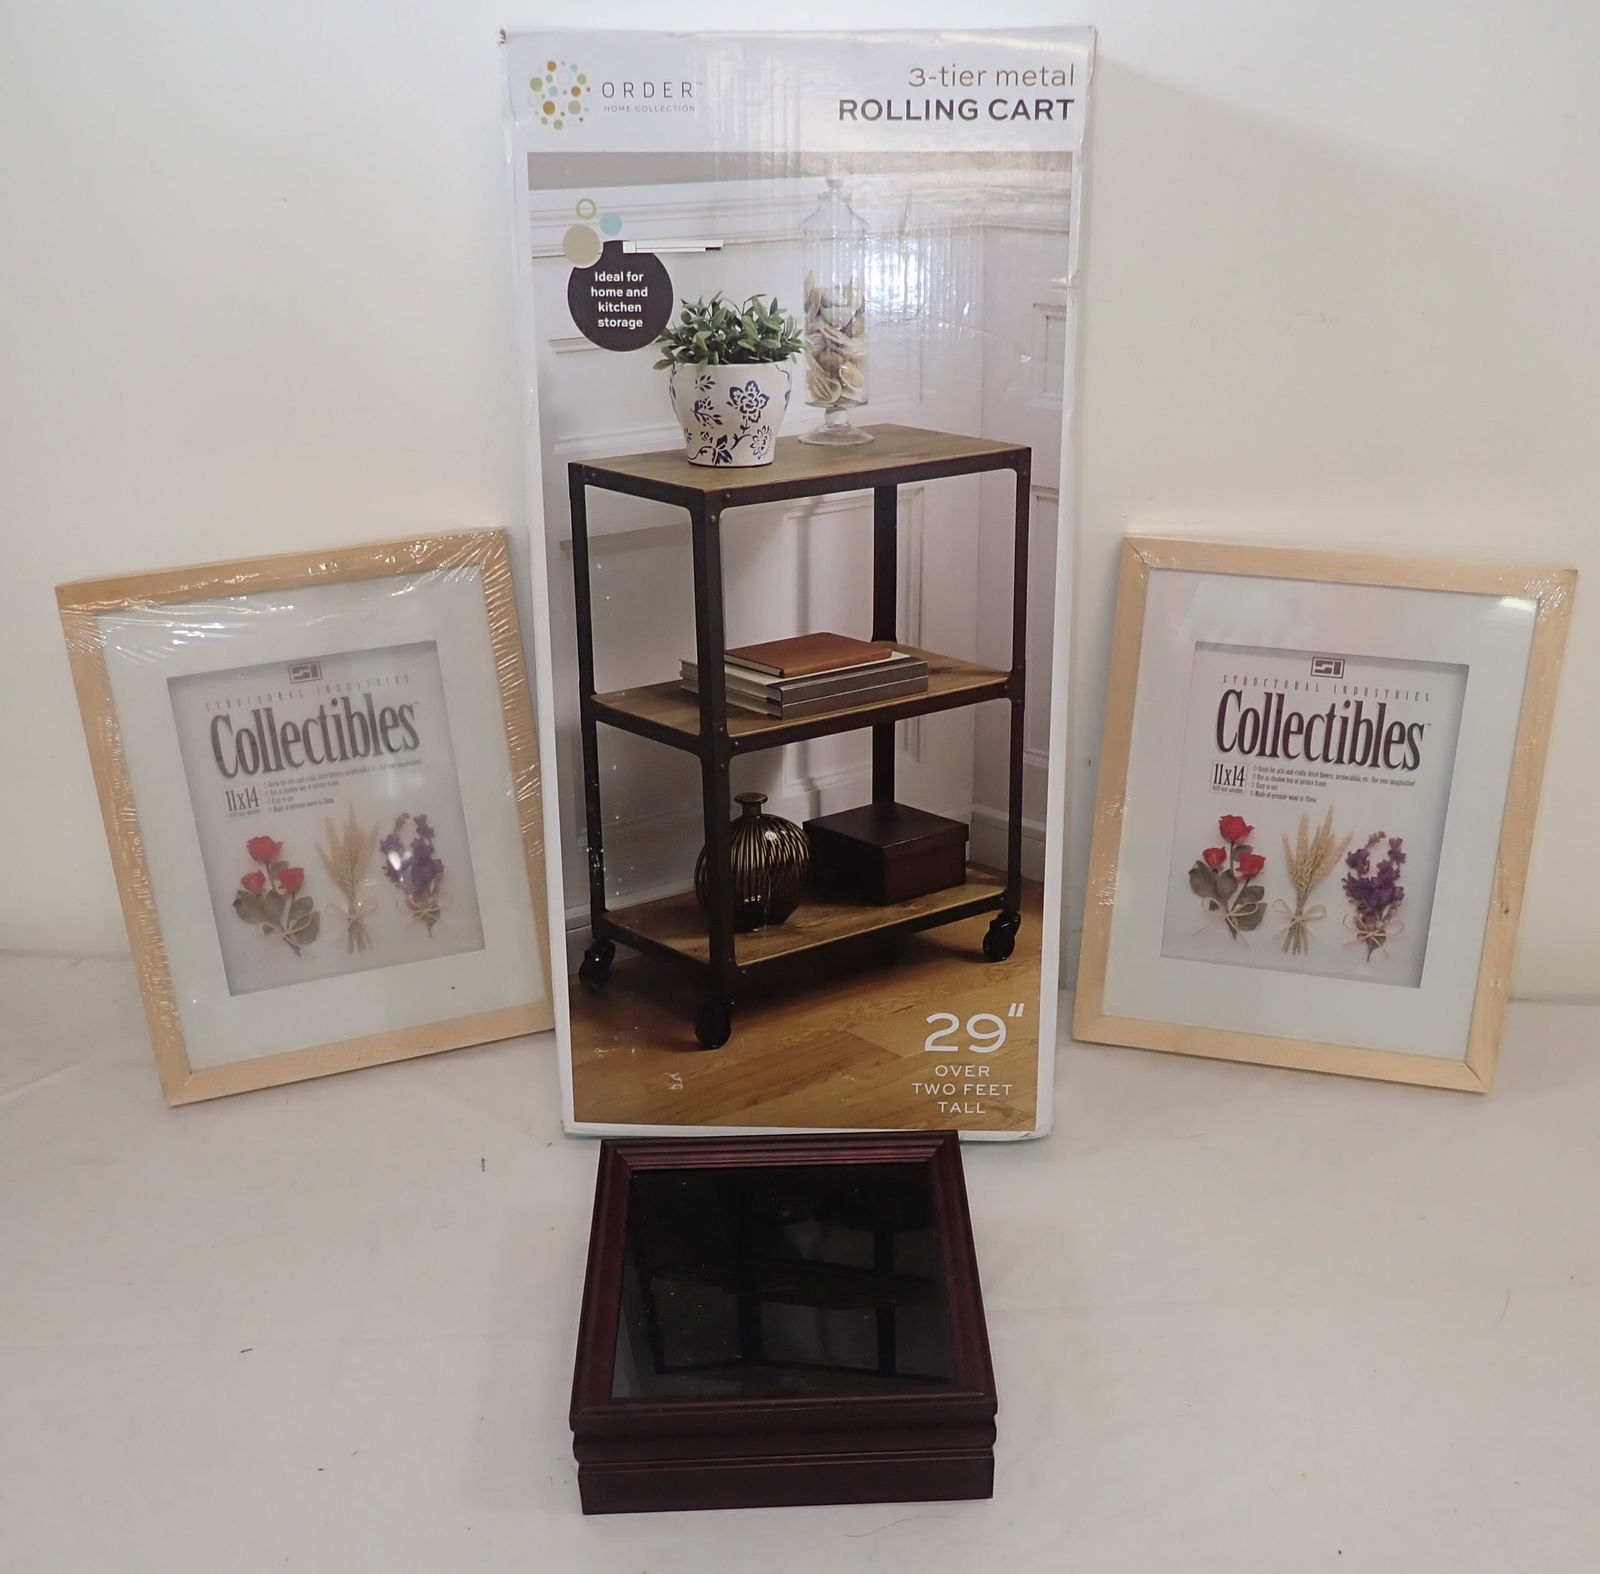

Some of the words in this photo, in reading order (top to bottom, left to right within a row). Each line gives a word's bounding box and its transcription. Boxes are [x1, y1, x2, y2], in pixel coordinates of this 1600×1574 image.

[908, 63, 988, 87] 3-tier
[996, 63, 1075, 87] metal
[602, 81, 693, 99] ORDER
[839, 98, 979, 121] ROLLING
[988, 98, 1075, 121] CART
[595, 271, 624, 282] Ideal
[626, 271, 644, 282] for
[591, 286, 623, 297] home
[626, 286, 648, 297] and
[598, 302, 642, 312] kitchen
[597, 317, 644, 330] storage
[1223, 675, 1320, 693] STRUCTURAL
[1333, 685, 1430, 703] INDUSTRIES
[210, 692, 420, 779] Collectibles
[1216, 689, 1425, 771] Collectibles
[1213, 762, 1245, 787] 11x14
[225, 786, 260, 812] 11x14
[924, 1002, 1025, 1054] 29"
[935, 1064, 990, 1078] OVER
[911, 1082, 956, 1095] TWO
[963, 1084, 1013, 1096] FEET
[937, 1101, 986, 1114] TALL
